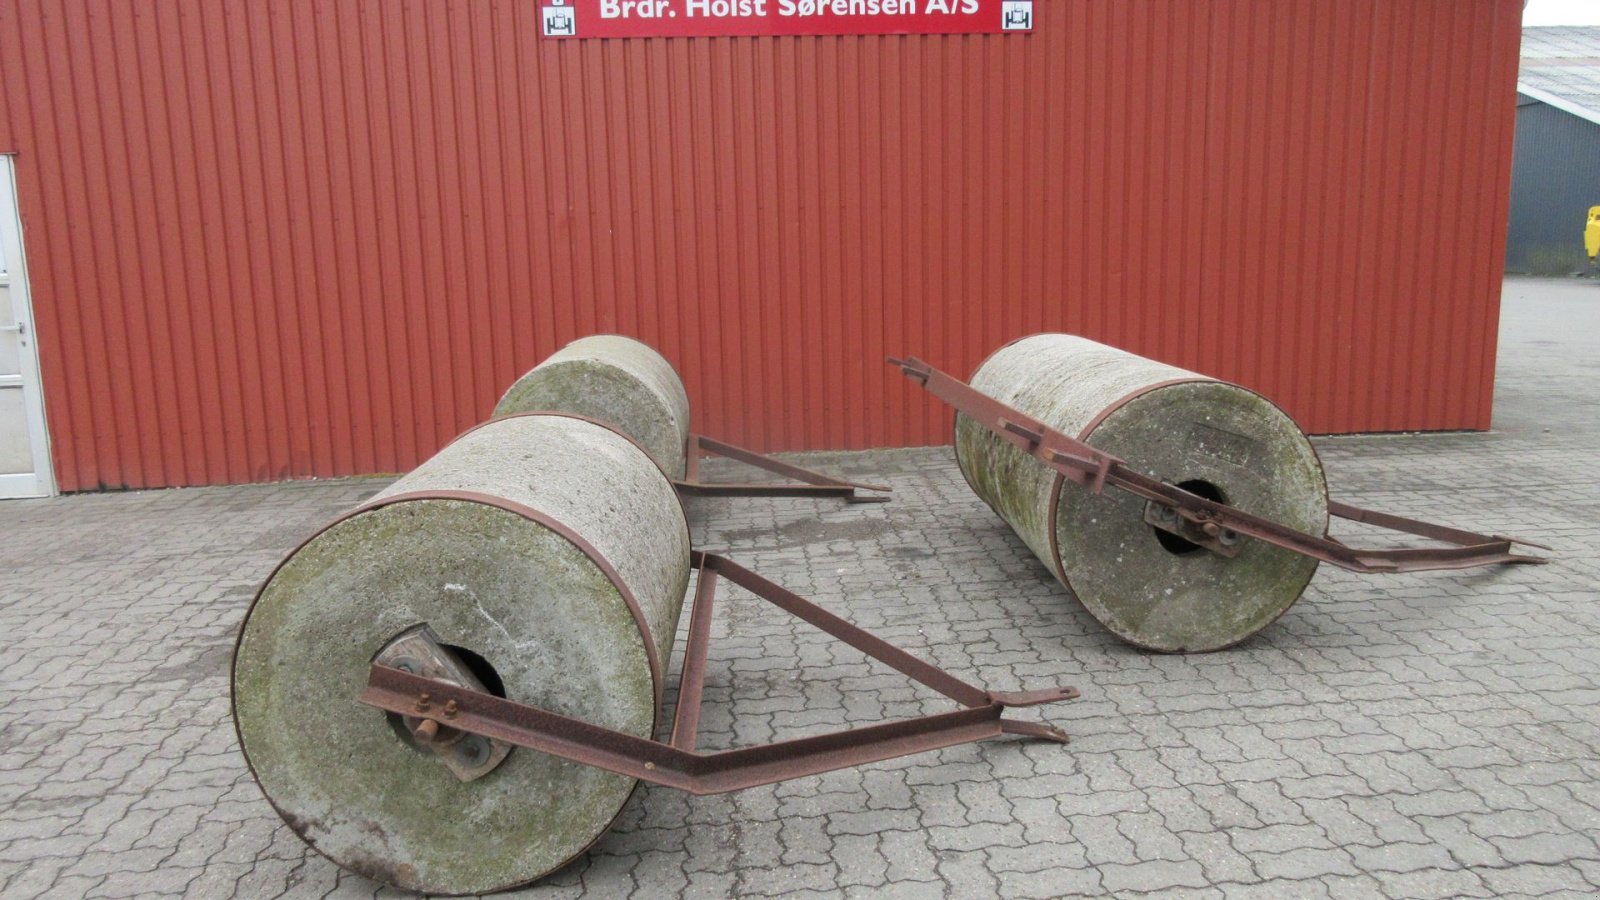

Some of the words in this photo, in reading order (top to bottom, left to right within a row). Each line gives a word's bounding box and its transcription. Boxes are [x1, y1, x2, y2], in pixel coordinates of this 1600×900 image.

[600, 0, 676, 18] Brdr.
[686, 0, 767, 17] Holst
[778, 0, 916, 17] Sørensen
[925, 0, 979, 14] A/S
